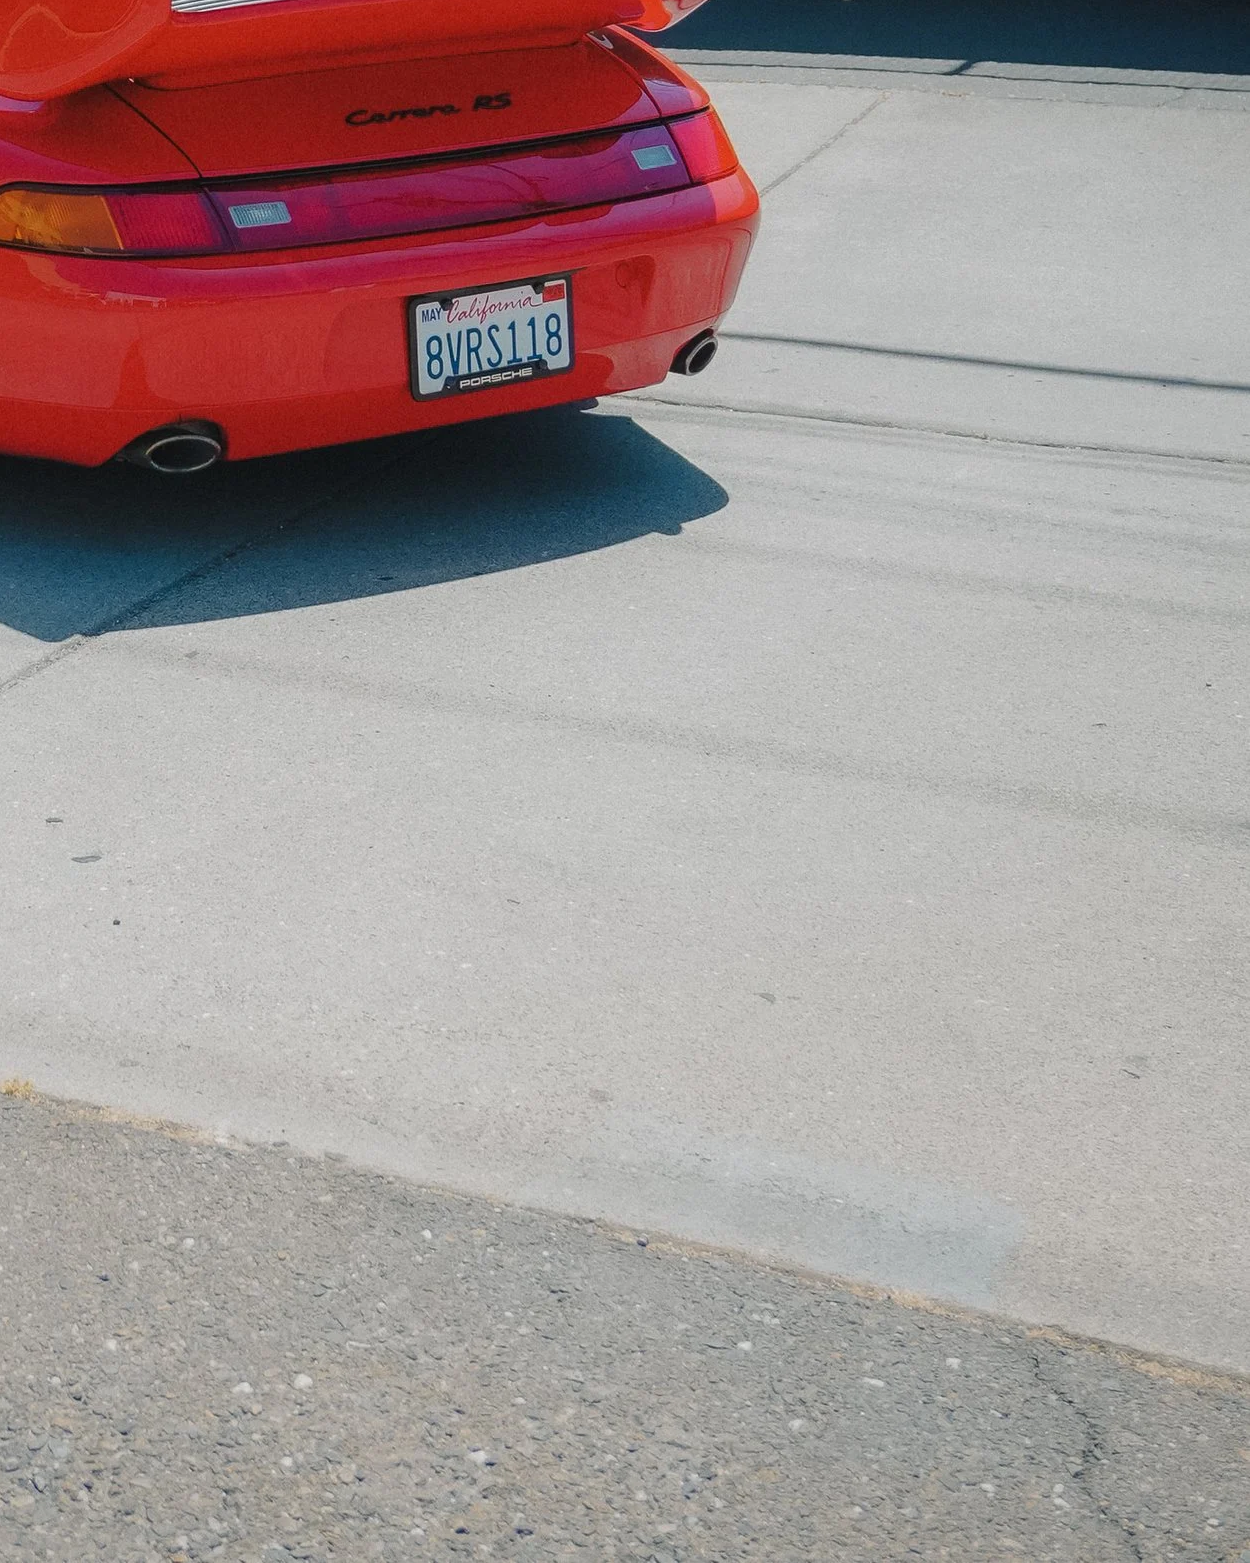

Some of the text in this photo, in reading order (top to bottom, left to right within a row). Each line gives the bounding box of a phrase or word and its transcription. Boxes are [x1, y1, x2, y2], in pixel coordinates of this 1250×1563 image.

[345, 92, 512, 126] Carrera RS
[421, 307, 442, 323] MAY
[446, 291, 543, 324] California
[426, 313, 562, 380] 8VRS118
[459, 367, 533, 389] PORSCHE
